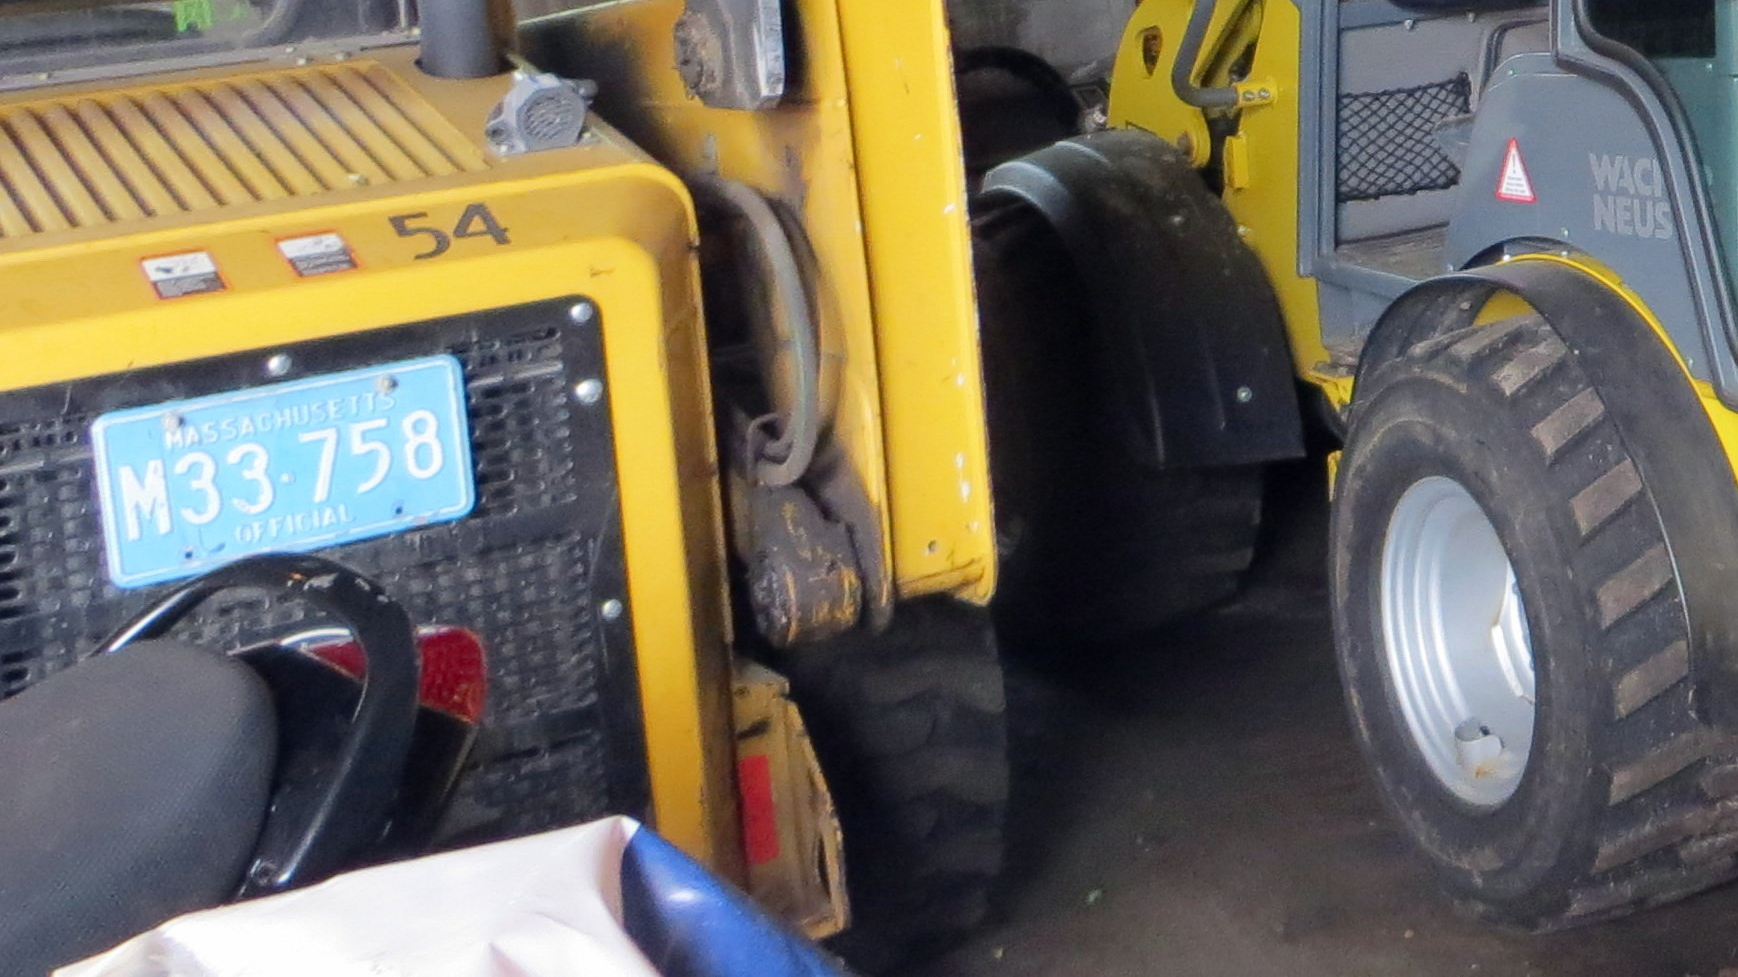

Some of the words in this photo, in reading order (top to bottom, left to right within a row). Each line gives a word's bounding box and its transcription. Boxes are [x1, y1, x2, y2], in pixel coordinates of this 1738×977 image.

[388, 203, 511, 260] 54
[165, 390, 396, 450] MASSACHUSETTS
[235, 504, 352, 543] OFFICIAL
